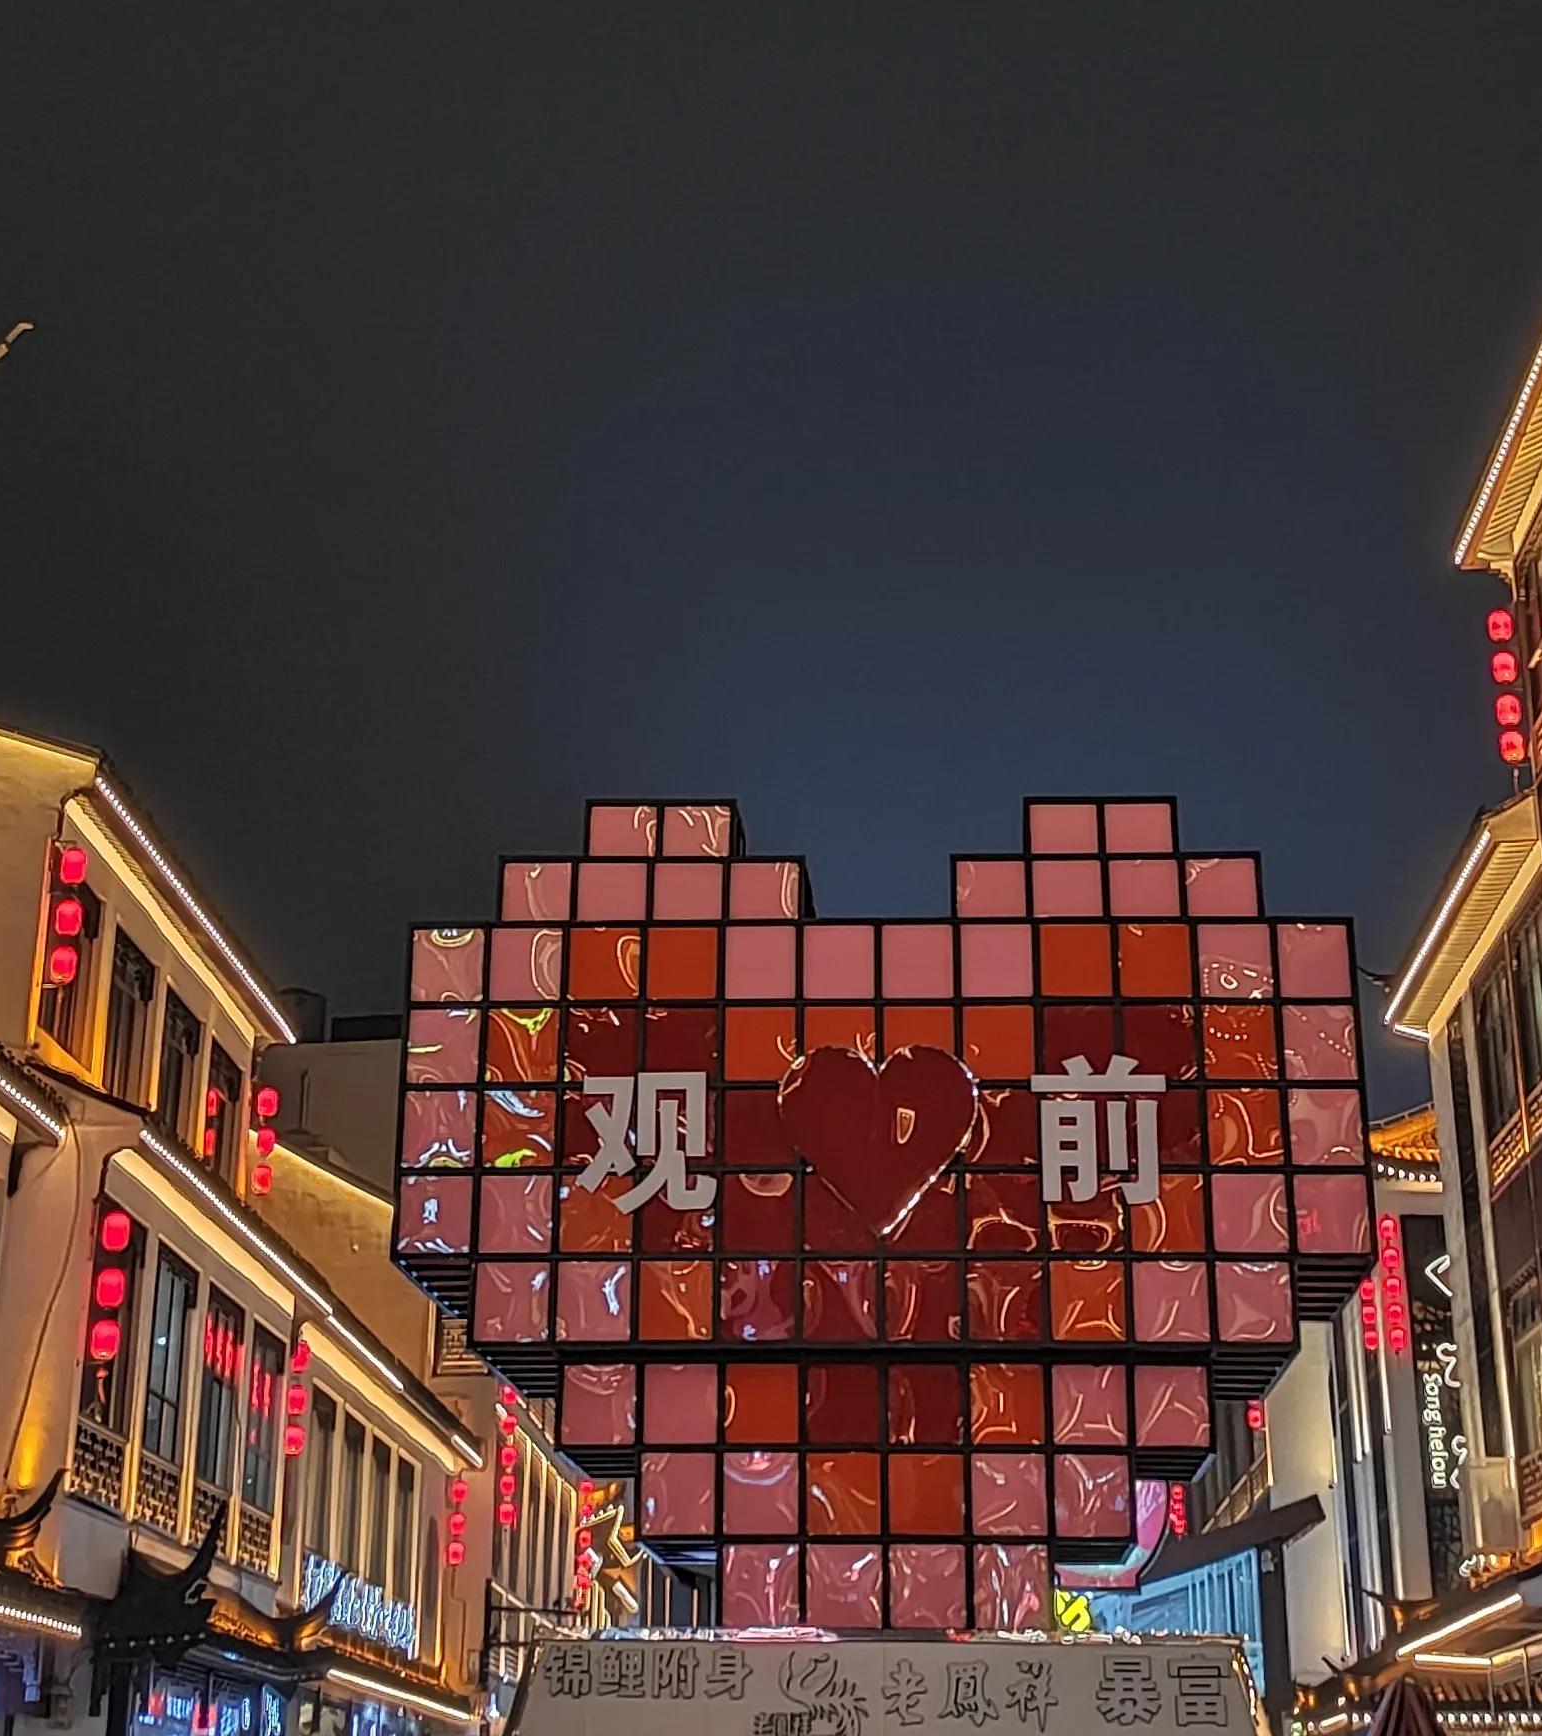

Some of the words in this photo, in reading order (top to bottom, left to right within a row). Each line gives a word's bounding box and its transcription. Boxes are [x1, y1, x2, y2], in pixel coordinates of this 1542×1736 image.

[574, 1070, 719, 1215] 观
[1031, 1054, 1170, 1208] 前
[542, 1645, 754, 1701] 锦鲤附身
[1094, 1654, 1235, 1728] 暴富
